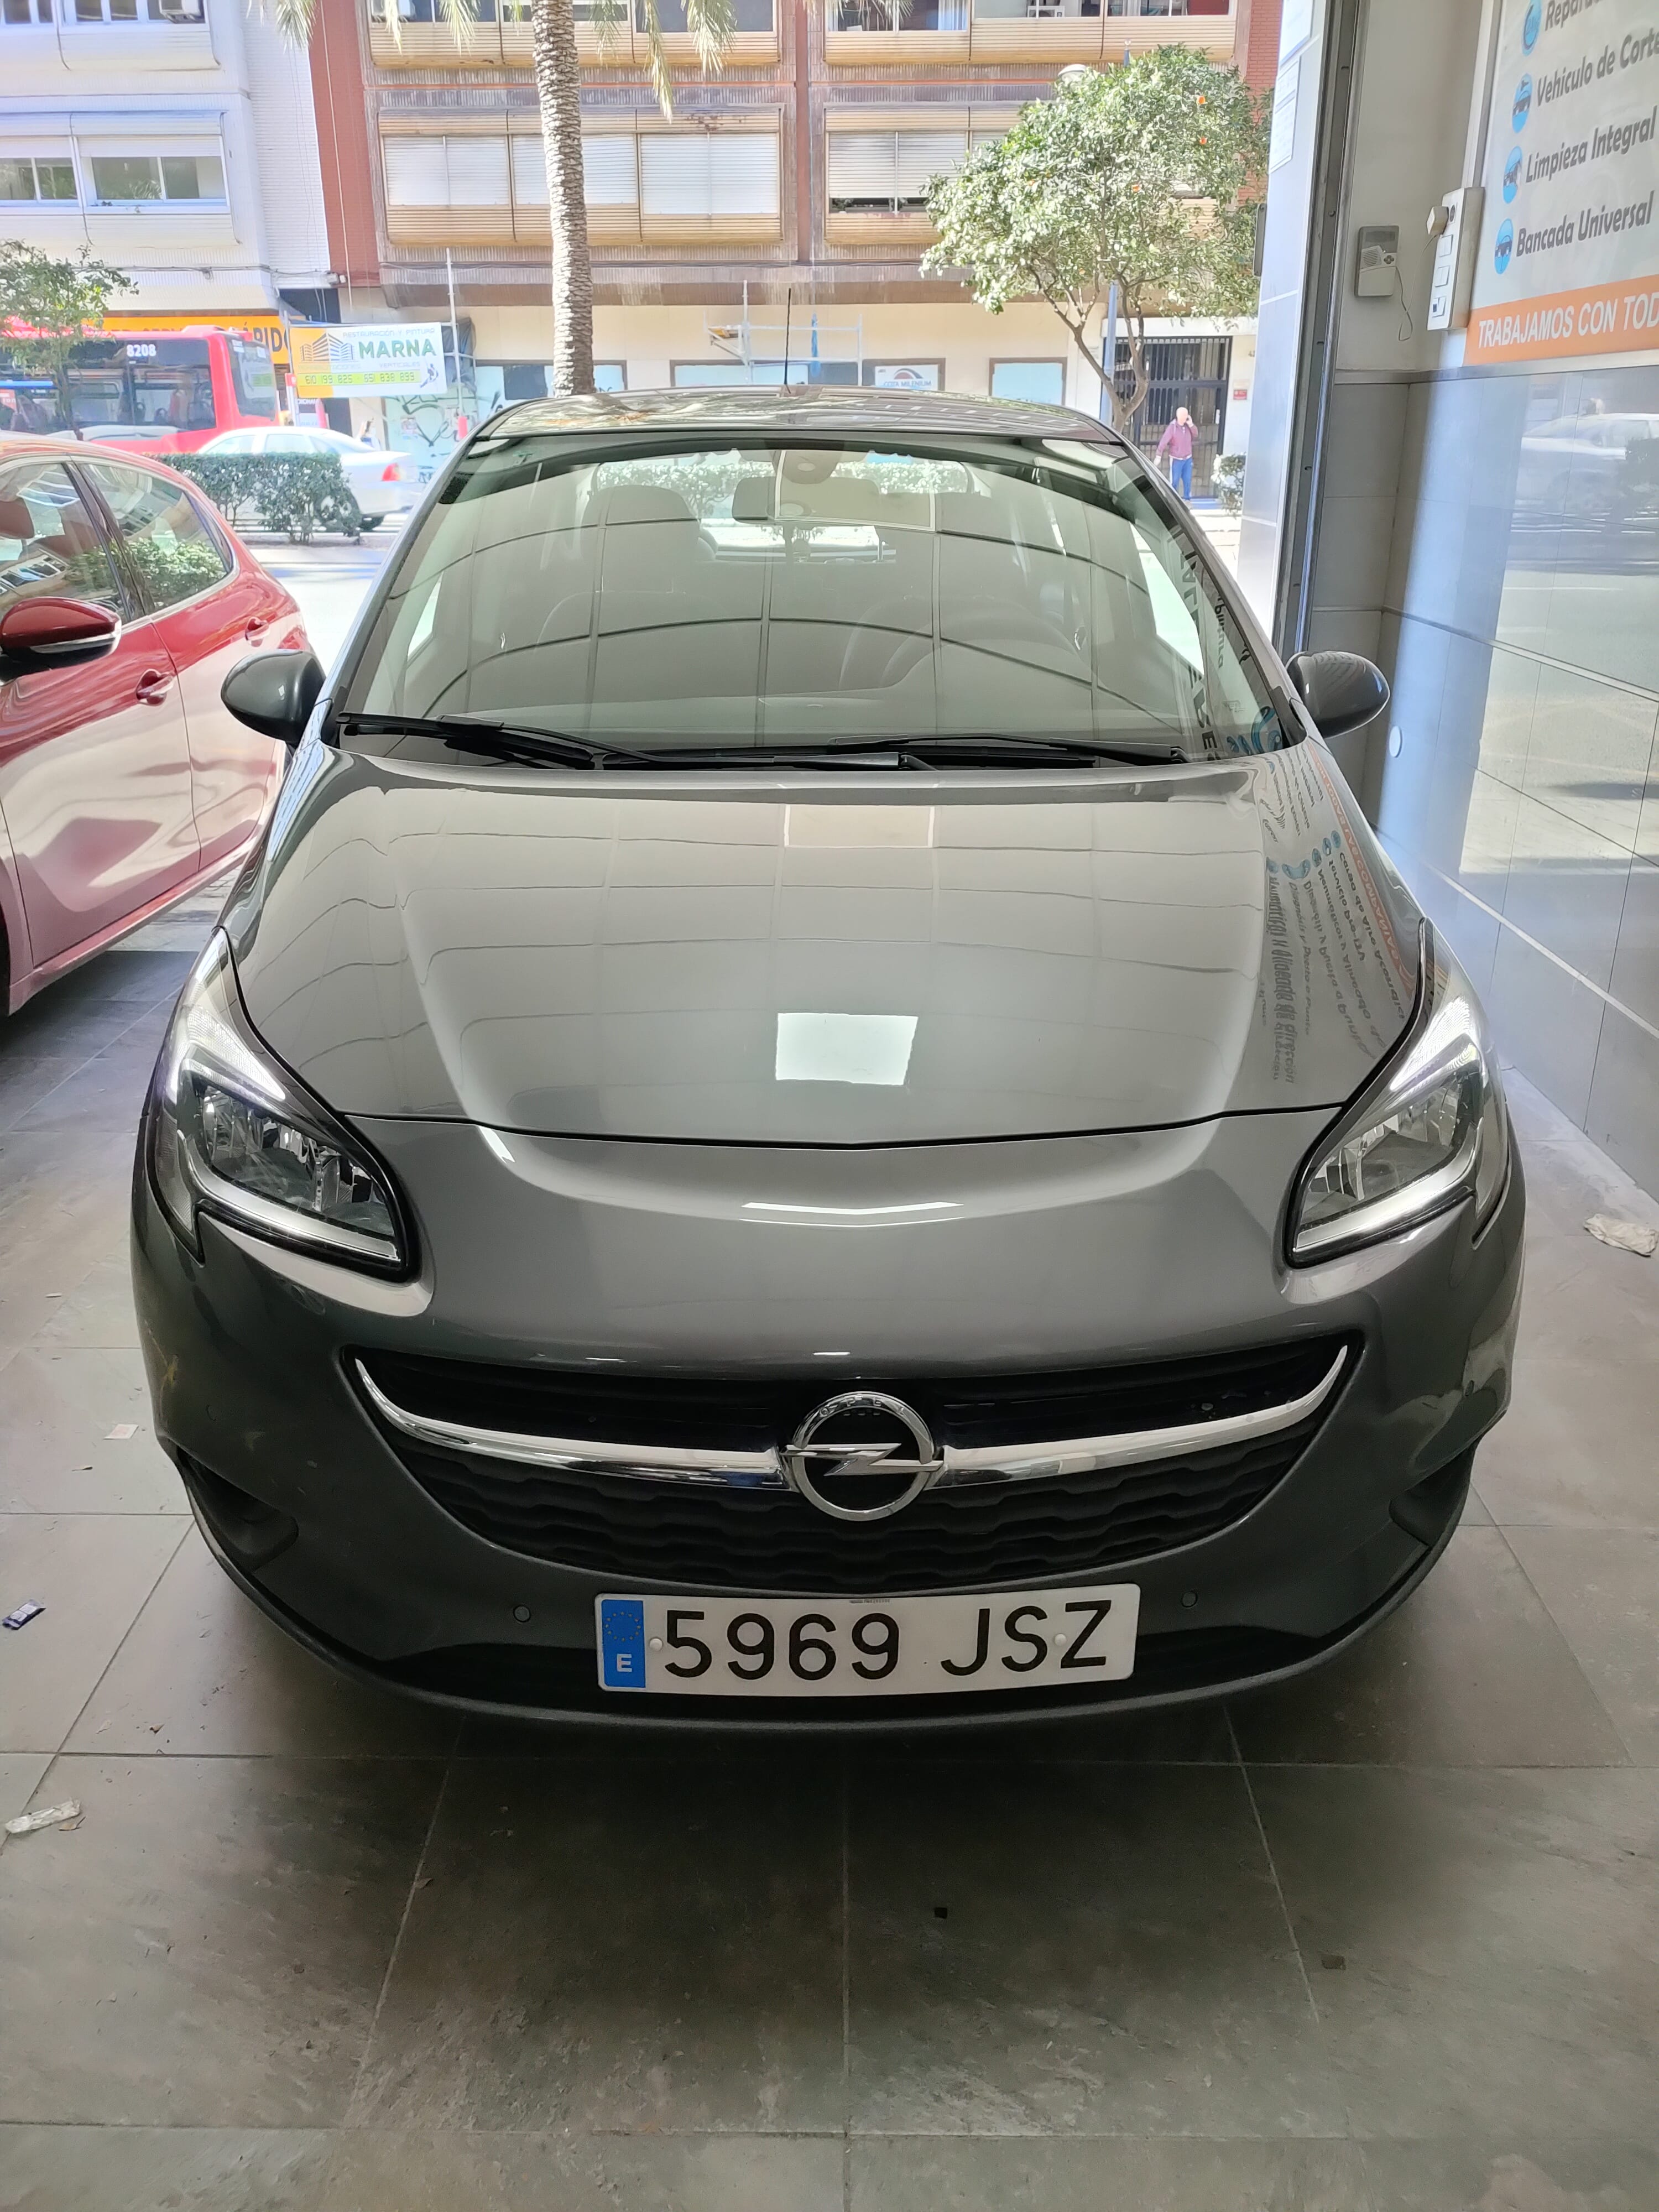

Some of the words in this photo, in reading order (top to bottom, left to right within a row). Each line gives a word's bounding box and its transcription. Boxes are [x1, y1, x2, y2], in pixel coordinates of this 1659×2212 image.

[1596, 45, 1615, 80] de
[1526, 142, 1588, 183] Limpieza
[1590, 105, 1658, 160] Integral
[1516, 214, 1574, 257] Bancada
[1578, 190, 1655, 241] Universal
[358, 338, 436, 359] MARNA
[1478, 305, 1574, 349] TRABAJAMOS
[1578, 299, 1618, 336] CON
[127, 344, 157, 357] 8208
[616, 1653, 633, 1673] E
[664, 1609, 900, 1681] 5969
[940, 1599, 1113, 1677] JSZ
